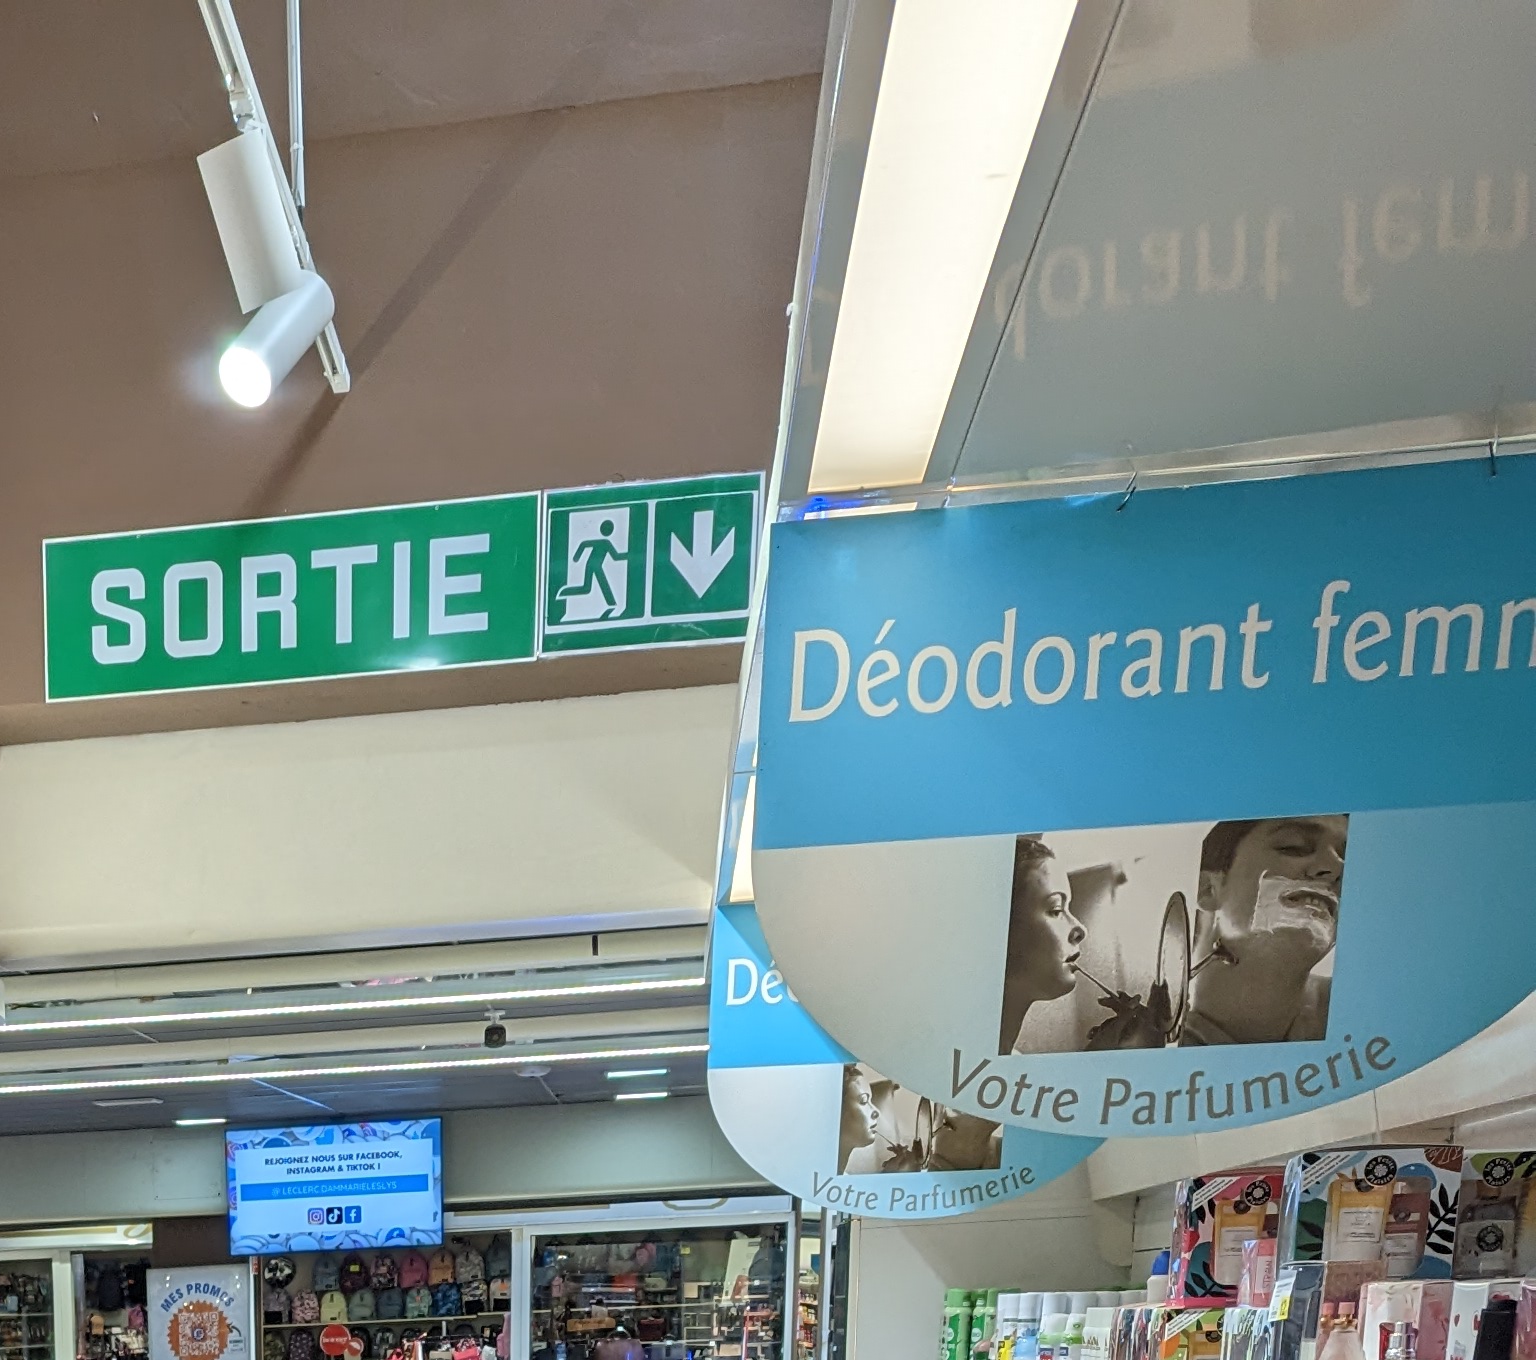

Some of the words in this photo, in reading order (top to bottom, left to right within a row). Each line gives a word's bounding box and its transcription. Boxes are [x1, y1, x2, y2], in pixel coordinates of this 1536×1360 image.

[90, 533, 491, 665] SORTIE
[788, 602, 1273, 722] Déodorant
[726, 958, 799, 1006] Dé
[951, 1047, 1079, 1123] Votre
[1100, 1032, 1398, 1126] Parfumerie
[264, 1155, 309, 1166] REJOIGNEZ
[311, 1154, 336, 1164] NOUS
[337, 1152, 354, 1162] SUR
[355, 1150, 403, 1161] FACEBOOK,
[286, 1164, 336, 1175] INSTAGRAM
[337, 1164, 344, 1172] &
[345, 1162, 375, 1172] TIKTOK
[813, 1171, 879, 1210] Votre
[889, 1165, 1037, 1213] Parfumerie
[160, 1288, 184, 1312] MES
[186, 1283, 235, 1307] PROMOS
